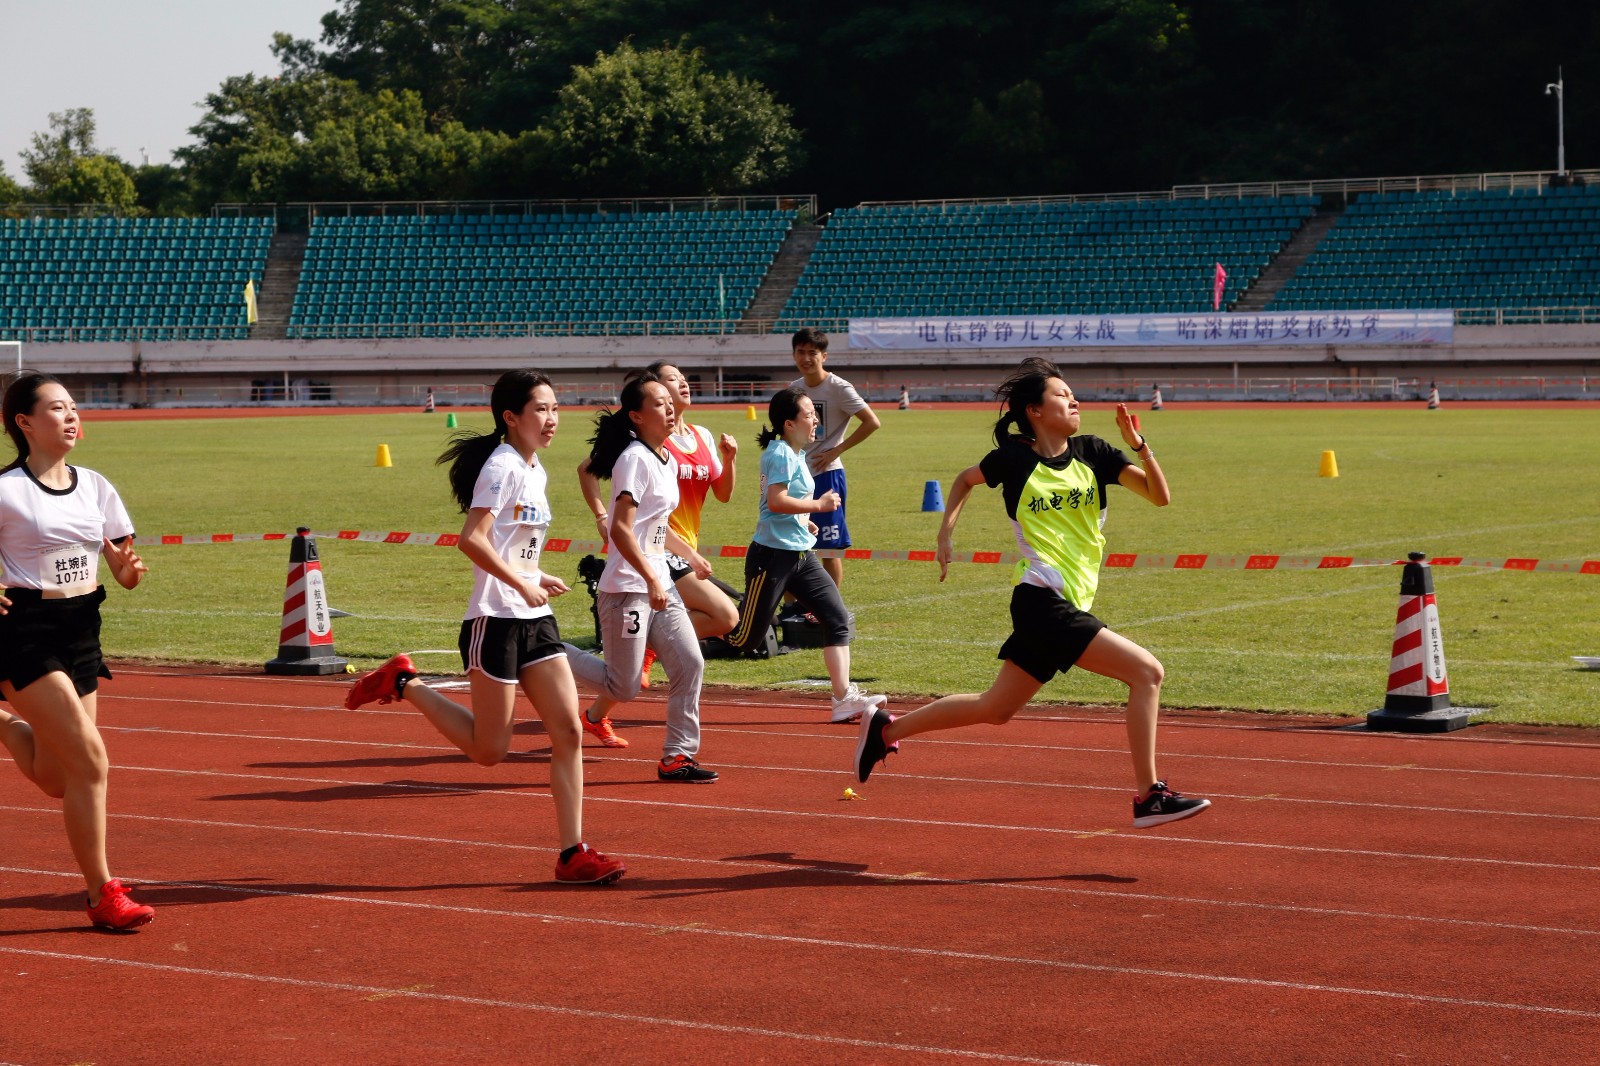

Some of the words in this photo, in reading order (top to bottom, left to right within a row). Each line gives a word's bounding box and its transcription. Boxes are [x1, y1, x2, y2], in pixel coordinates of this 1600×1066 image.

[1028, 486, 1095, 514] 机电学院
[822, 525, 840, 541] 25
[55, 568, 89, 585] 10719
[314, 589, 325, 633] 航天物业
[627, 610, 641, 635] 3
